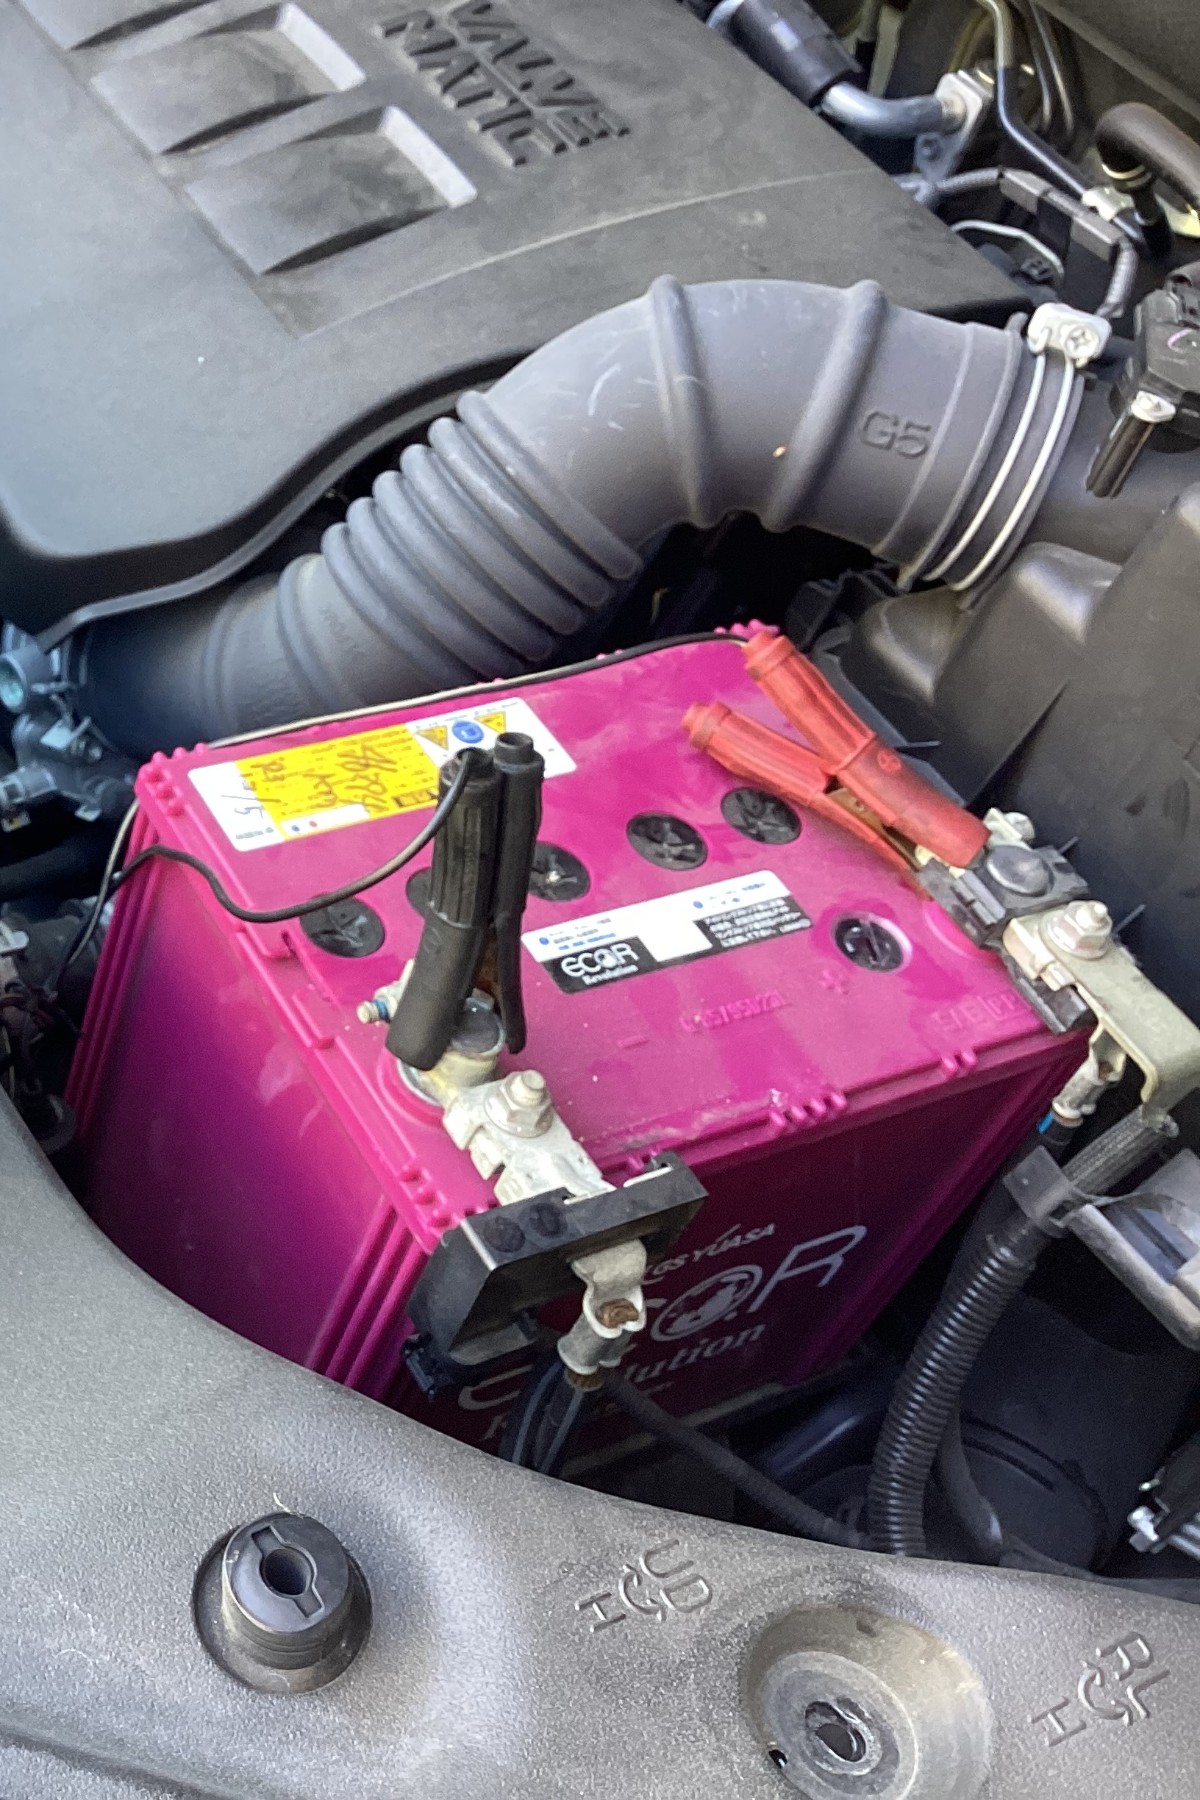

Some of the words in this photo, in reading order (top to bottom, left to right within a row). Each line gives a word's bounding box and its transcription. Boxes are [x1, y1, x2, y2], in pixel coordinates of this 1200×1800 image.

[377, 10, 569, 168] MATIC
[446, 0, 632, 148] VALVE
[861, 410, 931, 459] G5
[1096, 1632, 1171, 1718] RL
